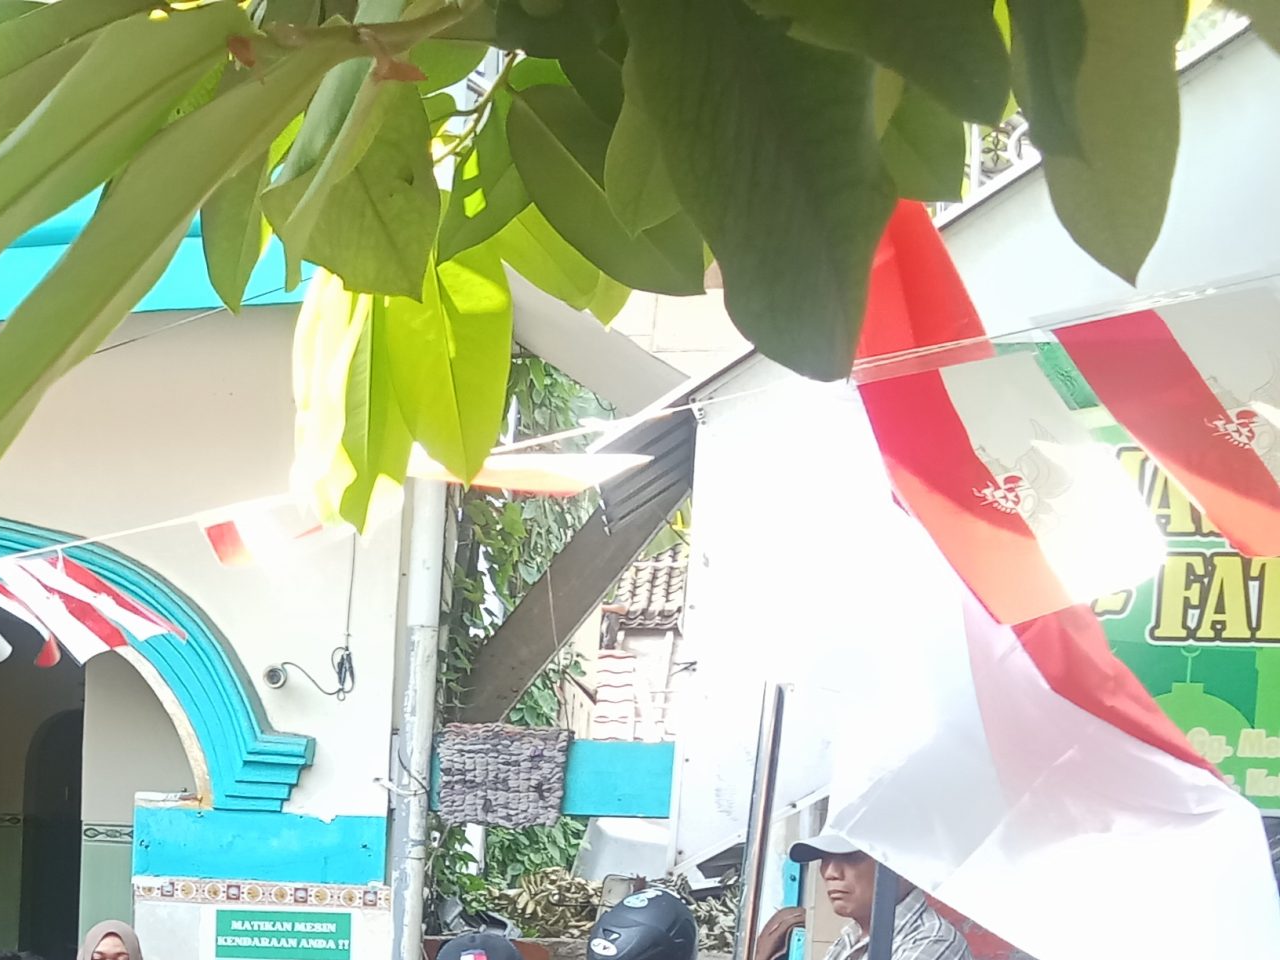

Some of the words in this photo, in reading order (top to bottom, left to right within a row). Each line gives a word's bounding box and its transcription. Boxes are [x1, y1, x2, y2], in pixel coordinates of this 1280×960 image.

[231, 920, 292, 931] MATIKAN
[294, 922, 336, 932] MESIN
[217, 936, 297, 947] KENDARAAN
[299, 938, 336, 949] ANDA
